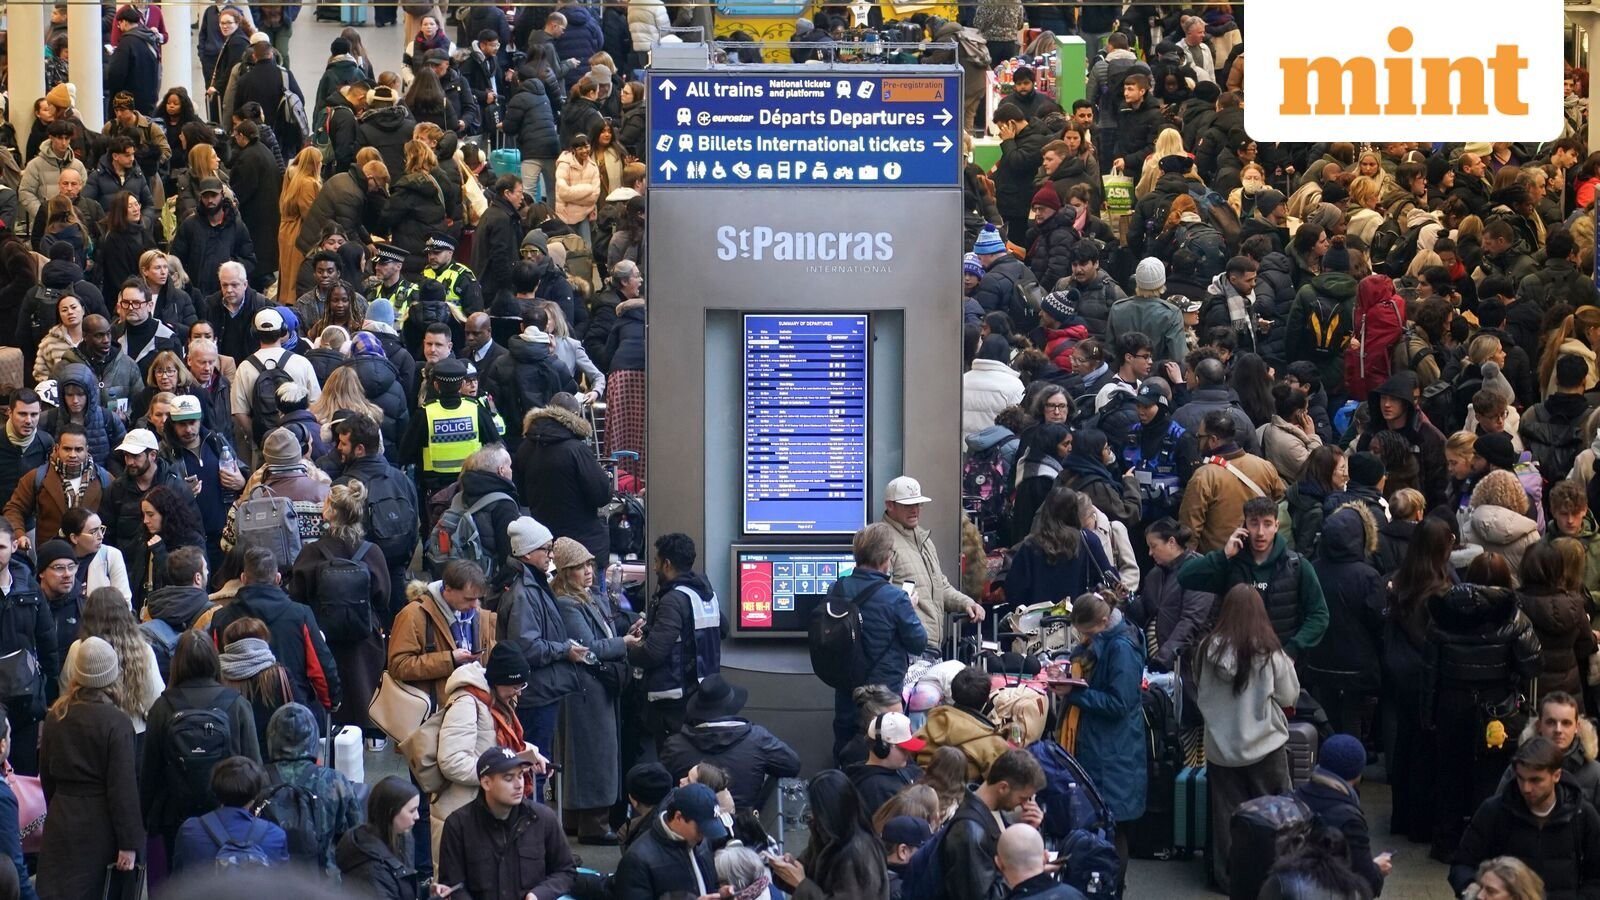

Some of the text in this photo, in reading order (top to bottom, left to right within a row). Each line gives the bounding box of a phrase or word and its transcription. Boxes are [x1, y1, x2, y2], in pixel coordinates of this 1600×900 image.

[685, 81, 764, 98] All trains
[769, 79, 832, 89] National tickets
[883, 81, 943, 90] Pre-registration
[769, 88, 825, 99] and platforms
[934, 90, 943, 99] A
[711, 108, 926, 128] eurostar Départs Departures
[698, 135, 926, 152] Billets International tickets
[752, 225, 894, 261] Pancras
[805, 265, 893, 273] INTERNATIONAL
[434, 422, 472, 433] POLICE
